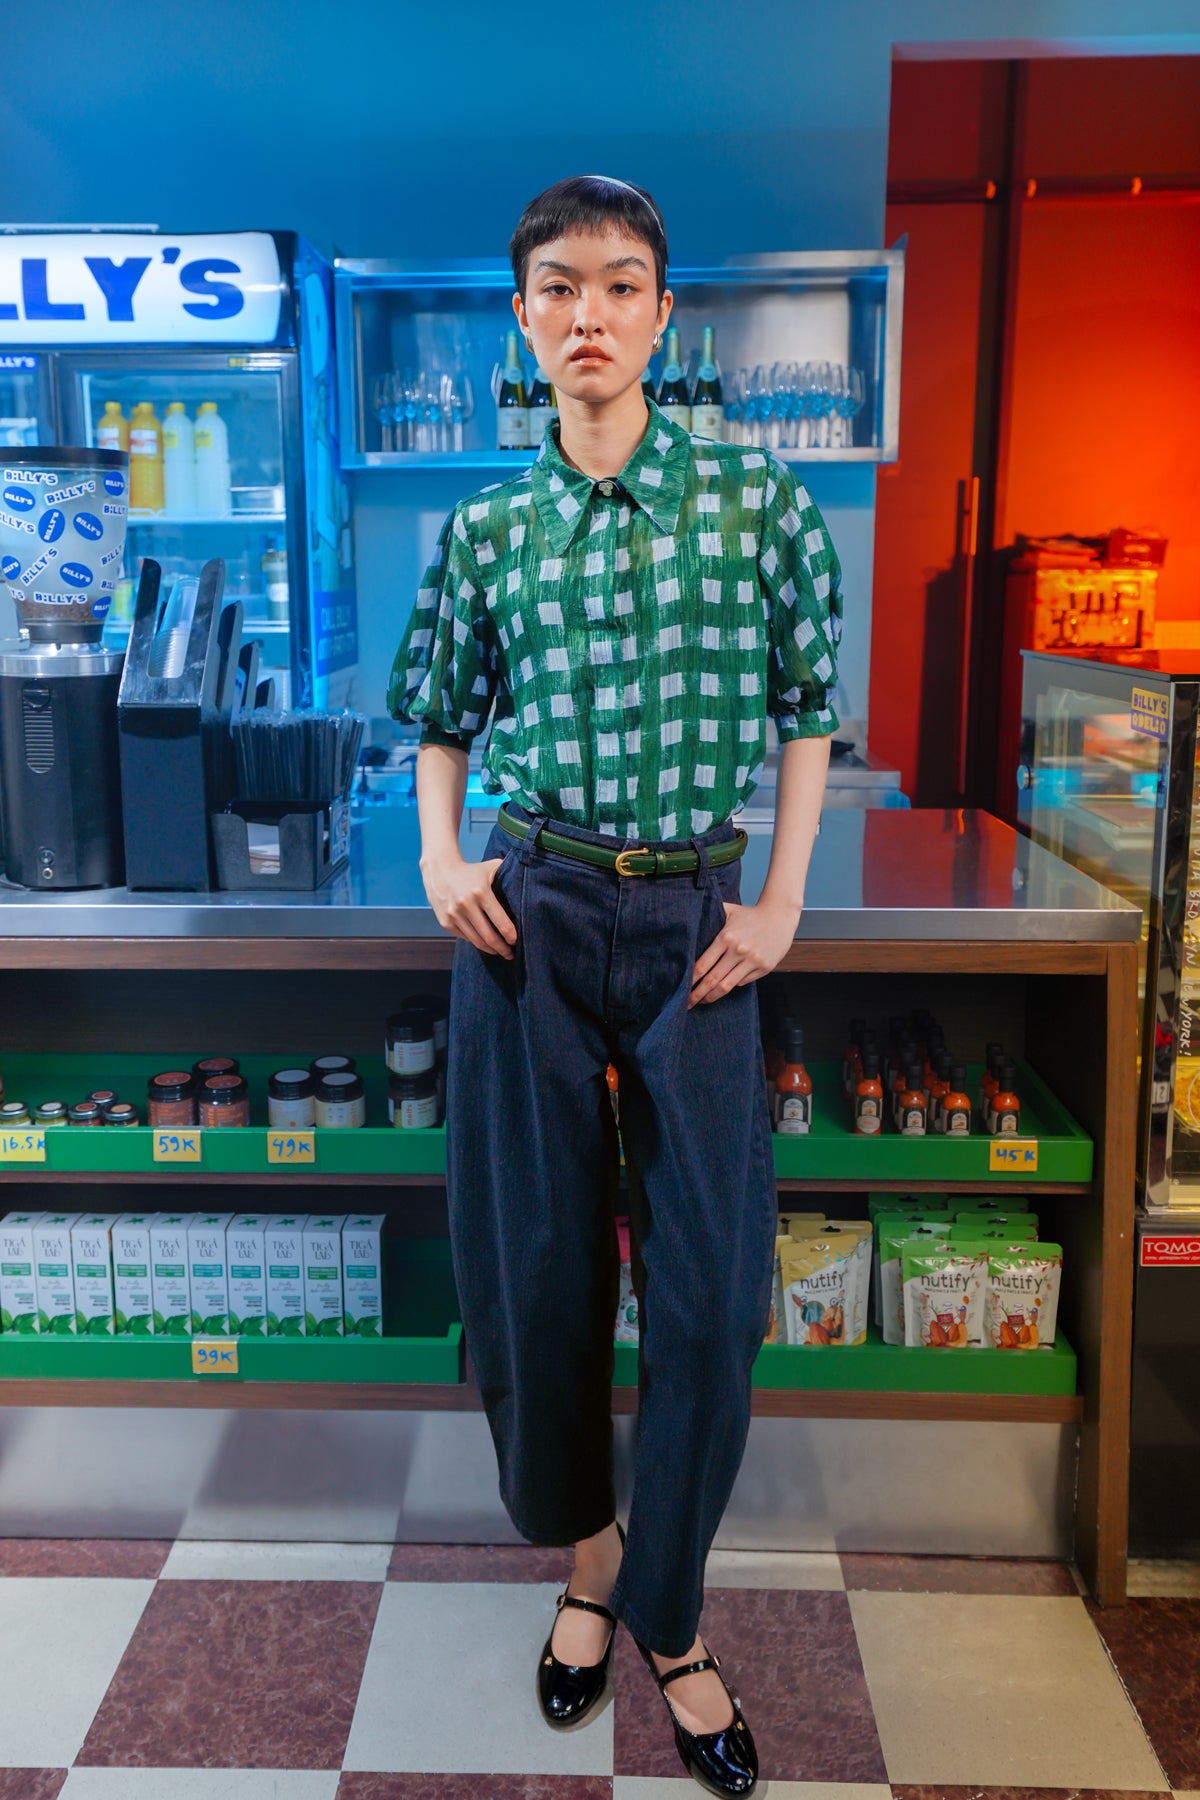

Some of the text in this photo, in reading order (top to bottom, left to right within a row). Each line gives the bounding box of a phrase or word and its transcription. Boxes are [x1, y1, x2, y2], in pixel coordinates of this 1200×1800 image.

[800, 1270, 845, 1289] nutify
[921, 1273, 970, 1292] nutify
[992, 1274, 1043, 1294] nutify
